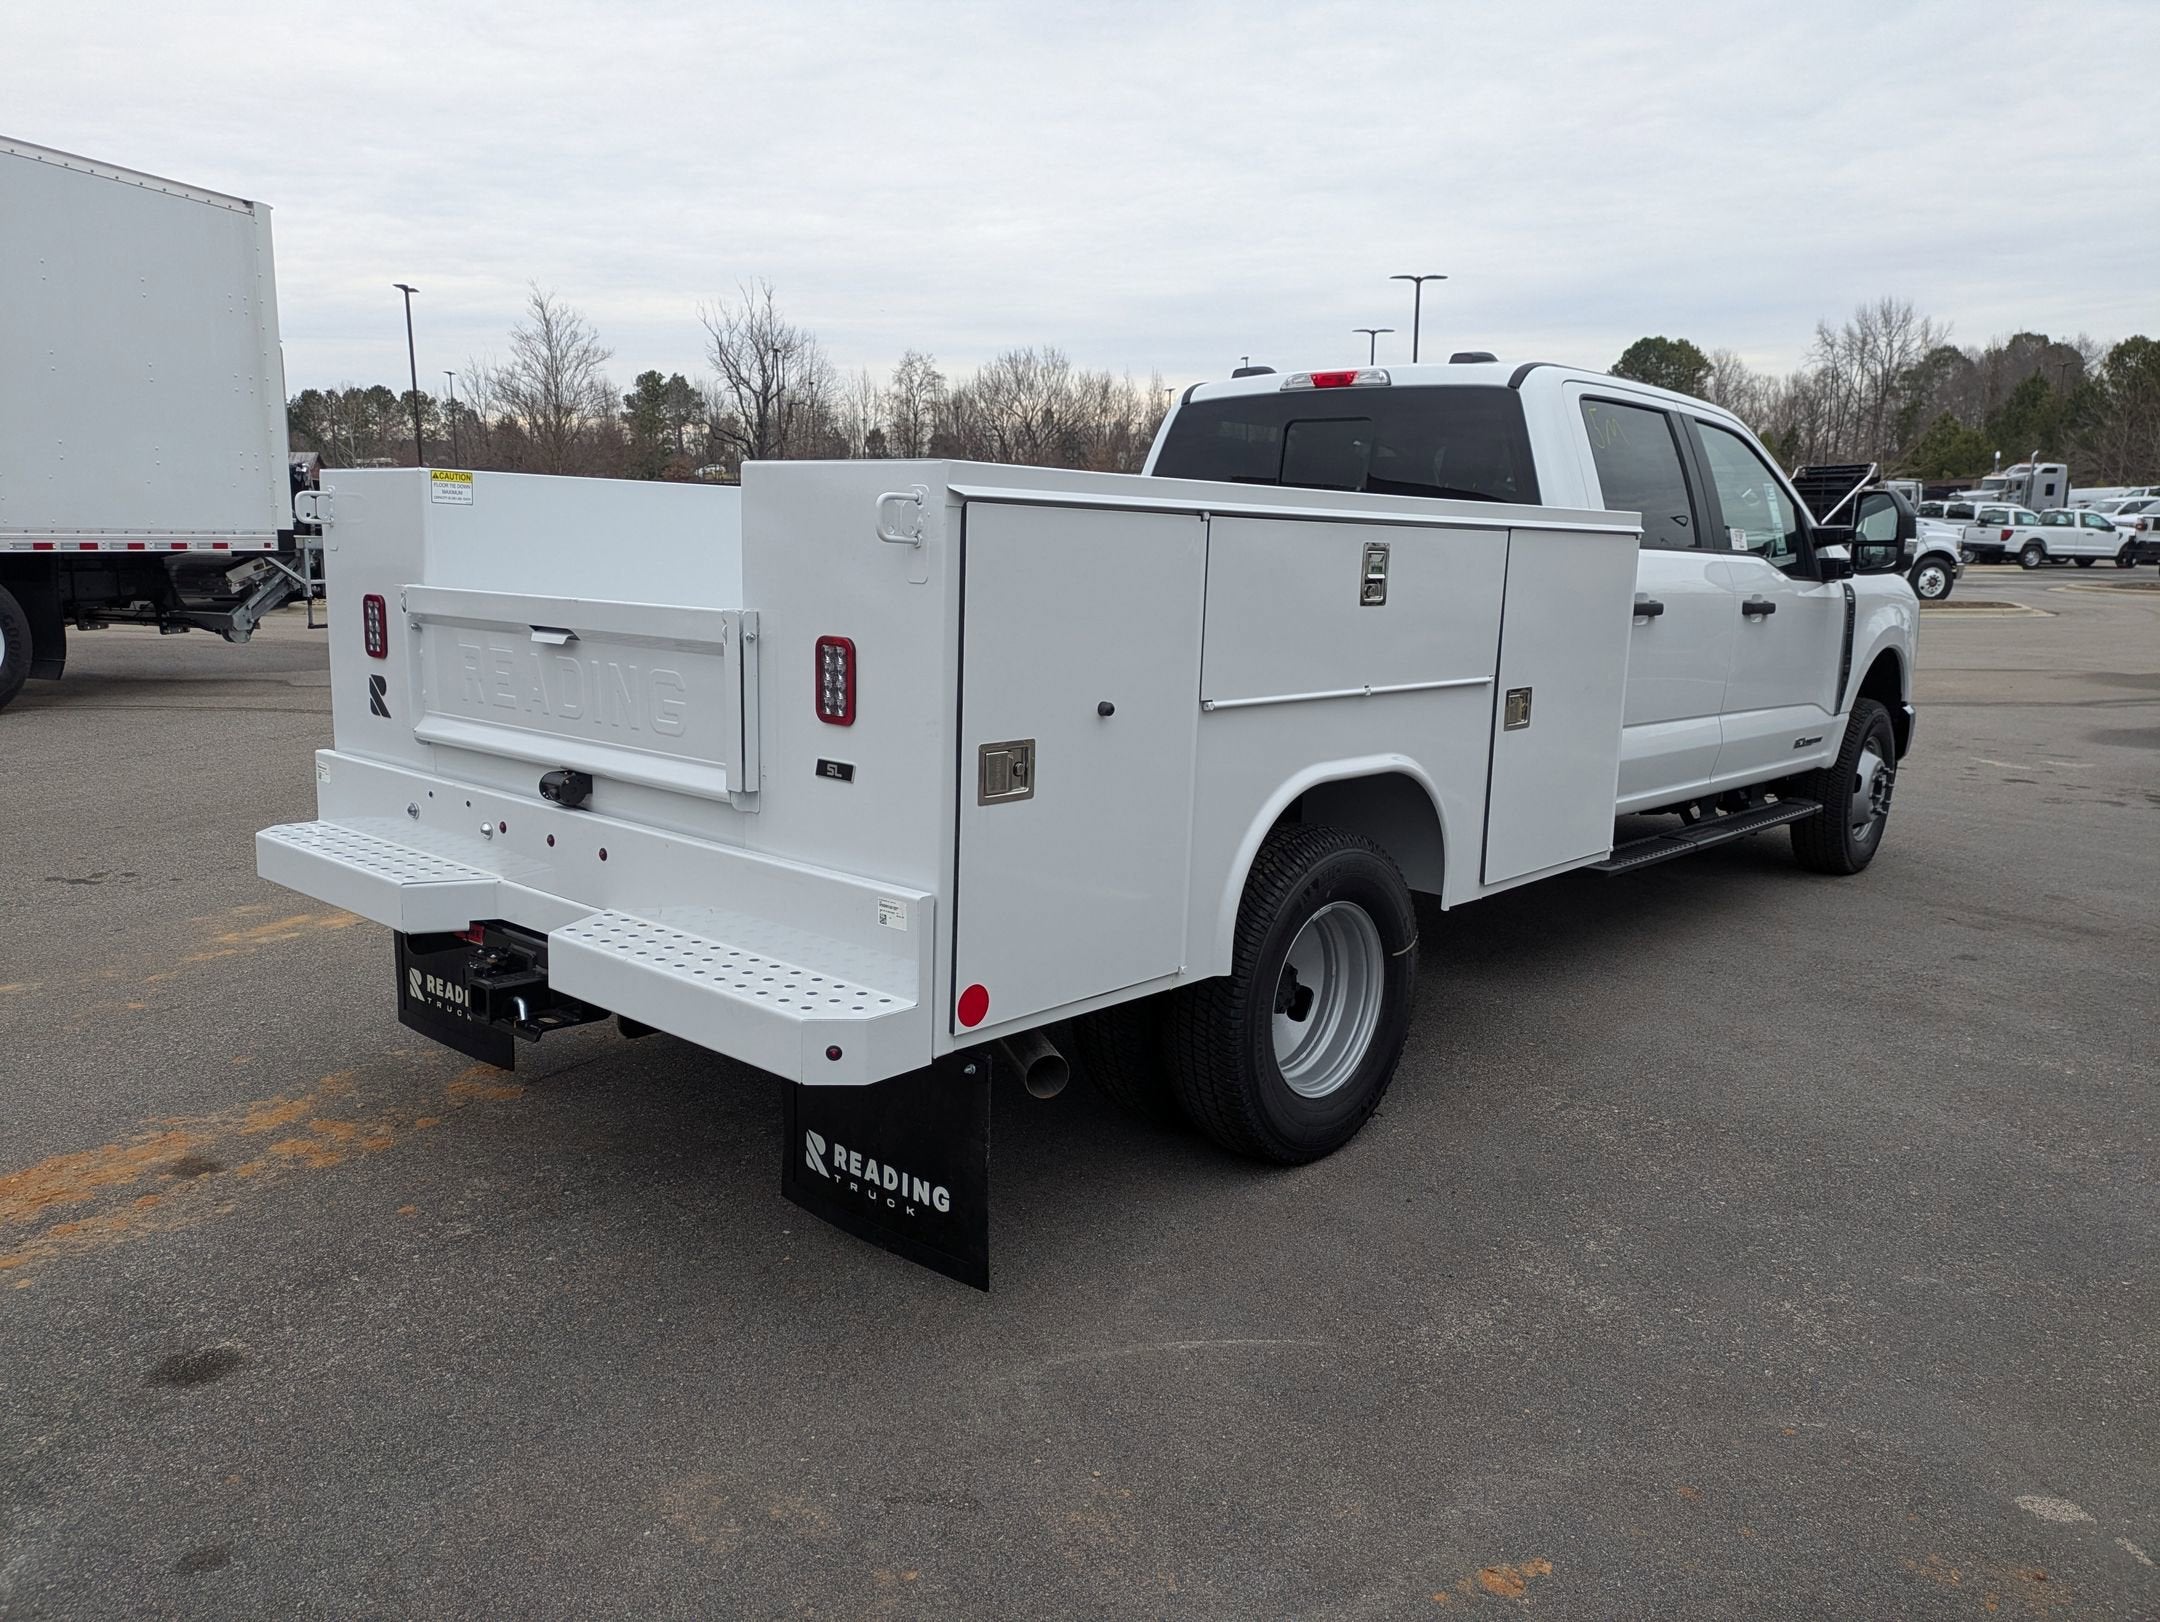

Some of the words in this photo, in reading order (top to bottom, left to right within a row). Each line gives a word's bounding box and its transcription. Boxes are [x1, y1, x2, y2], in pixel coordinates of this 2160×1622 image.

[439, 472, 471, 481] CAUTION
[460, 644, 687, 738] READING
[826, 763, 843, 778] SL
[427, 974, 470, 1007] READI
[834, 1143, 951, 1213] READING
[834, 1174, 916, 1217] TRUCK
